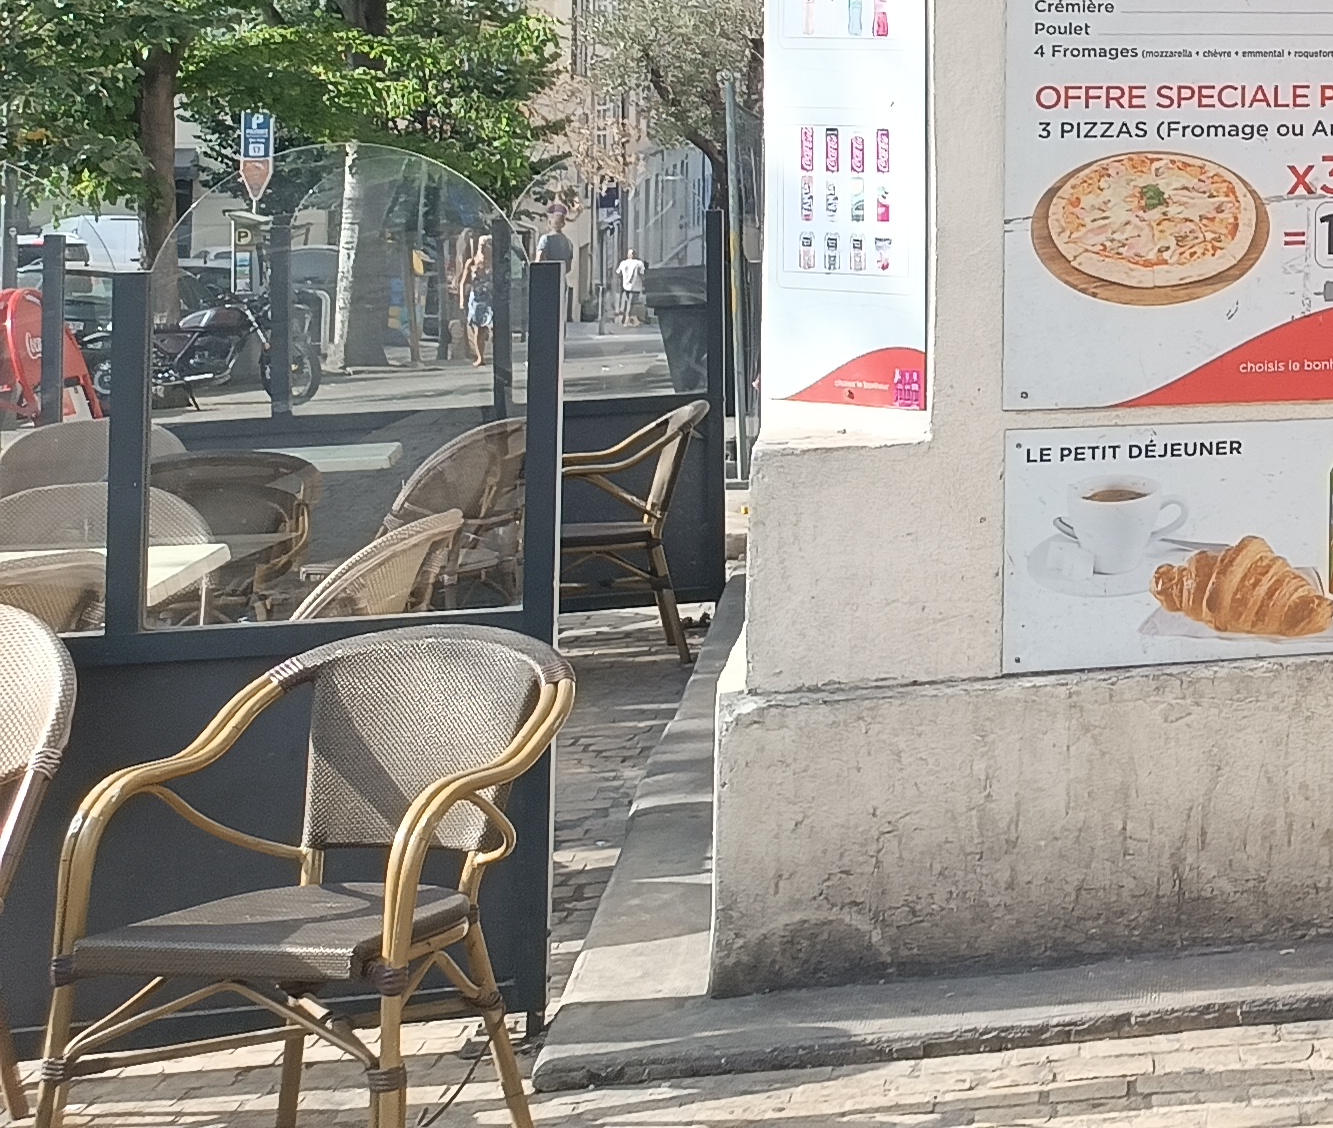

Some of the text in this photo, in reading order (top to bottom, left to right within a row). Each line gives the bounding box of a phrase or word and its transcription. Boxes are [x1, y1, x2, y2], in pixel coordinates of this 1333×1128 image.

[1034, 0, 1115, 13] Crémière
[1034, 22, 1090, 35] Poulet
[1034, 46, 1045, 58] 4
[1051, 45, 1138, 59] Fromages
[1141, 49, 1192, 59] (mozzarella
[1242, 49, 1284, 58] emmental
[1035, 85, 1146, 109] OFFRE
[1156, 85, 1311, 109] SPECIALE
[1038, 122, 1051, 138] 3
[1060, 121, 1148, 139] PIZZAS
[1157, 120, 1268, 140] (Fromage
[1277, 123, 1304, 138] ou
[237, 230, 249, 241] P
[1239, 360, 1285, 373] choisis
[1289, 360, 1300, 371] le
[1026, 440, 1242, 463] LE PETIT DÉJEUNER
